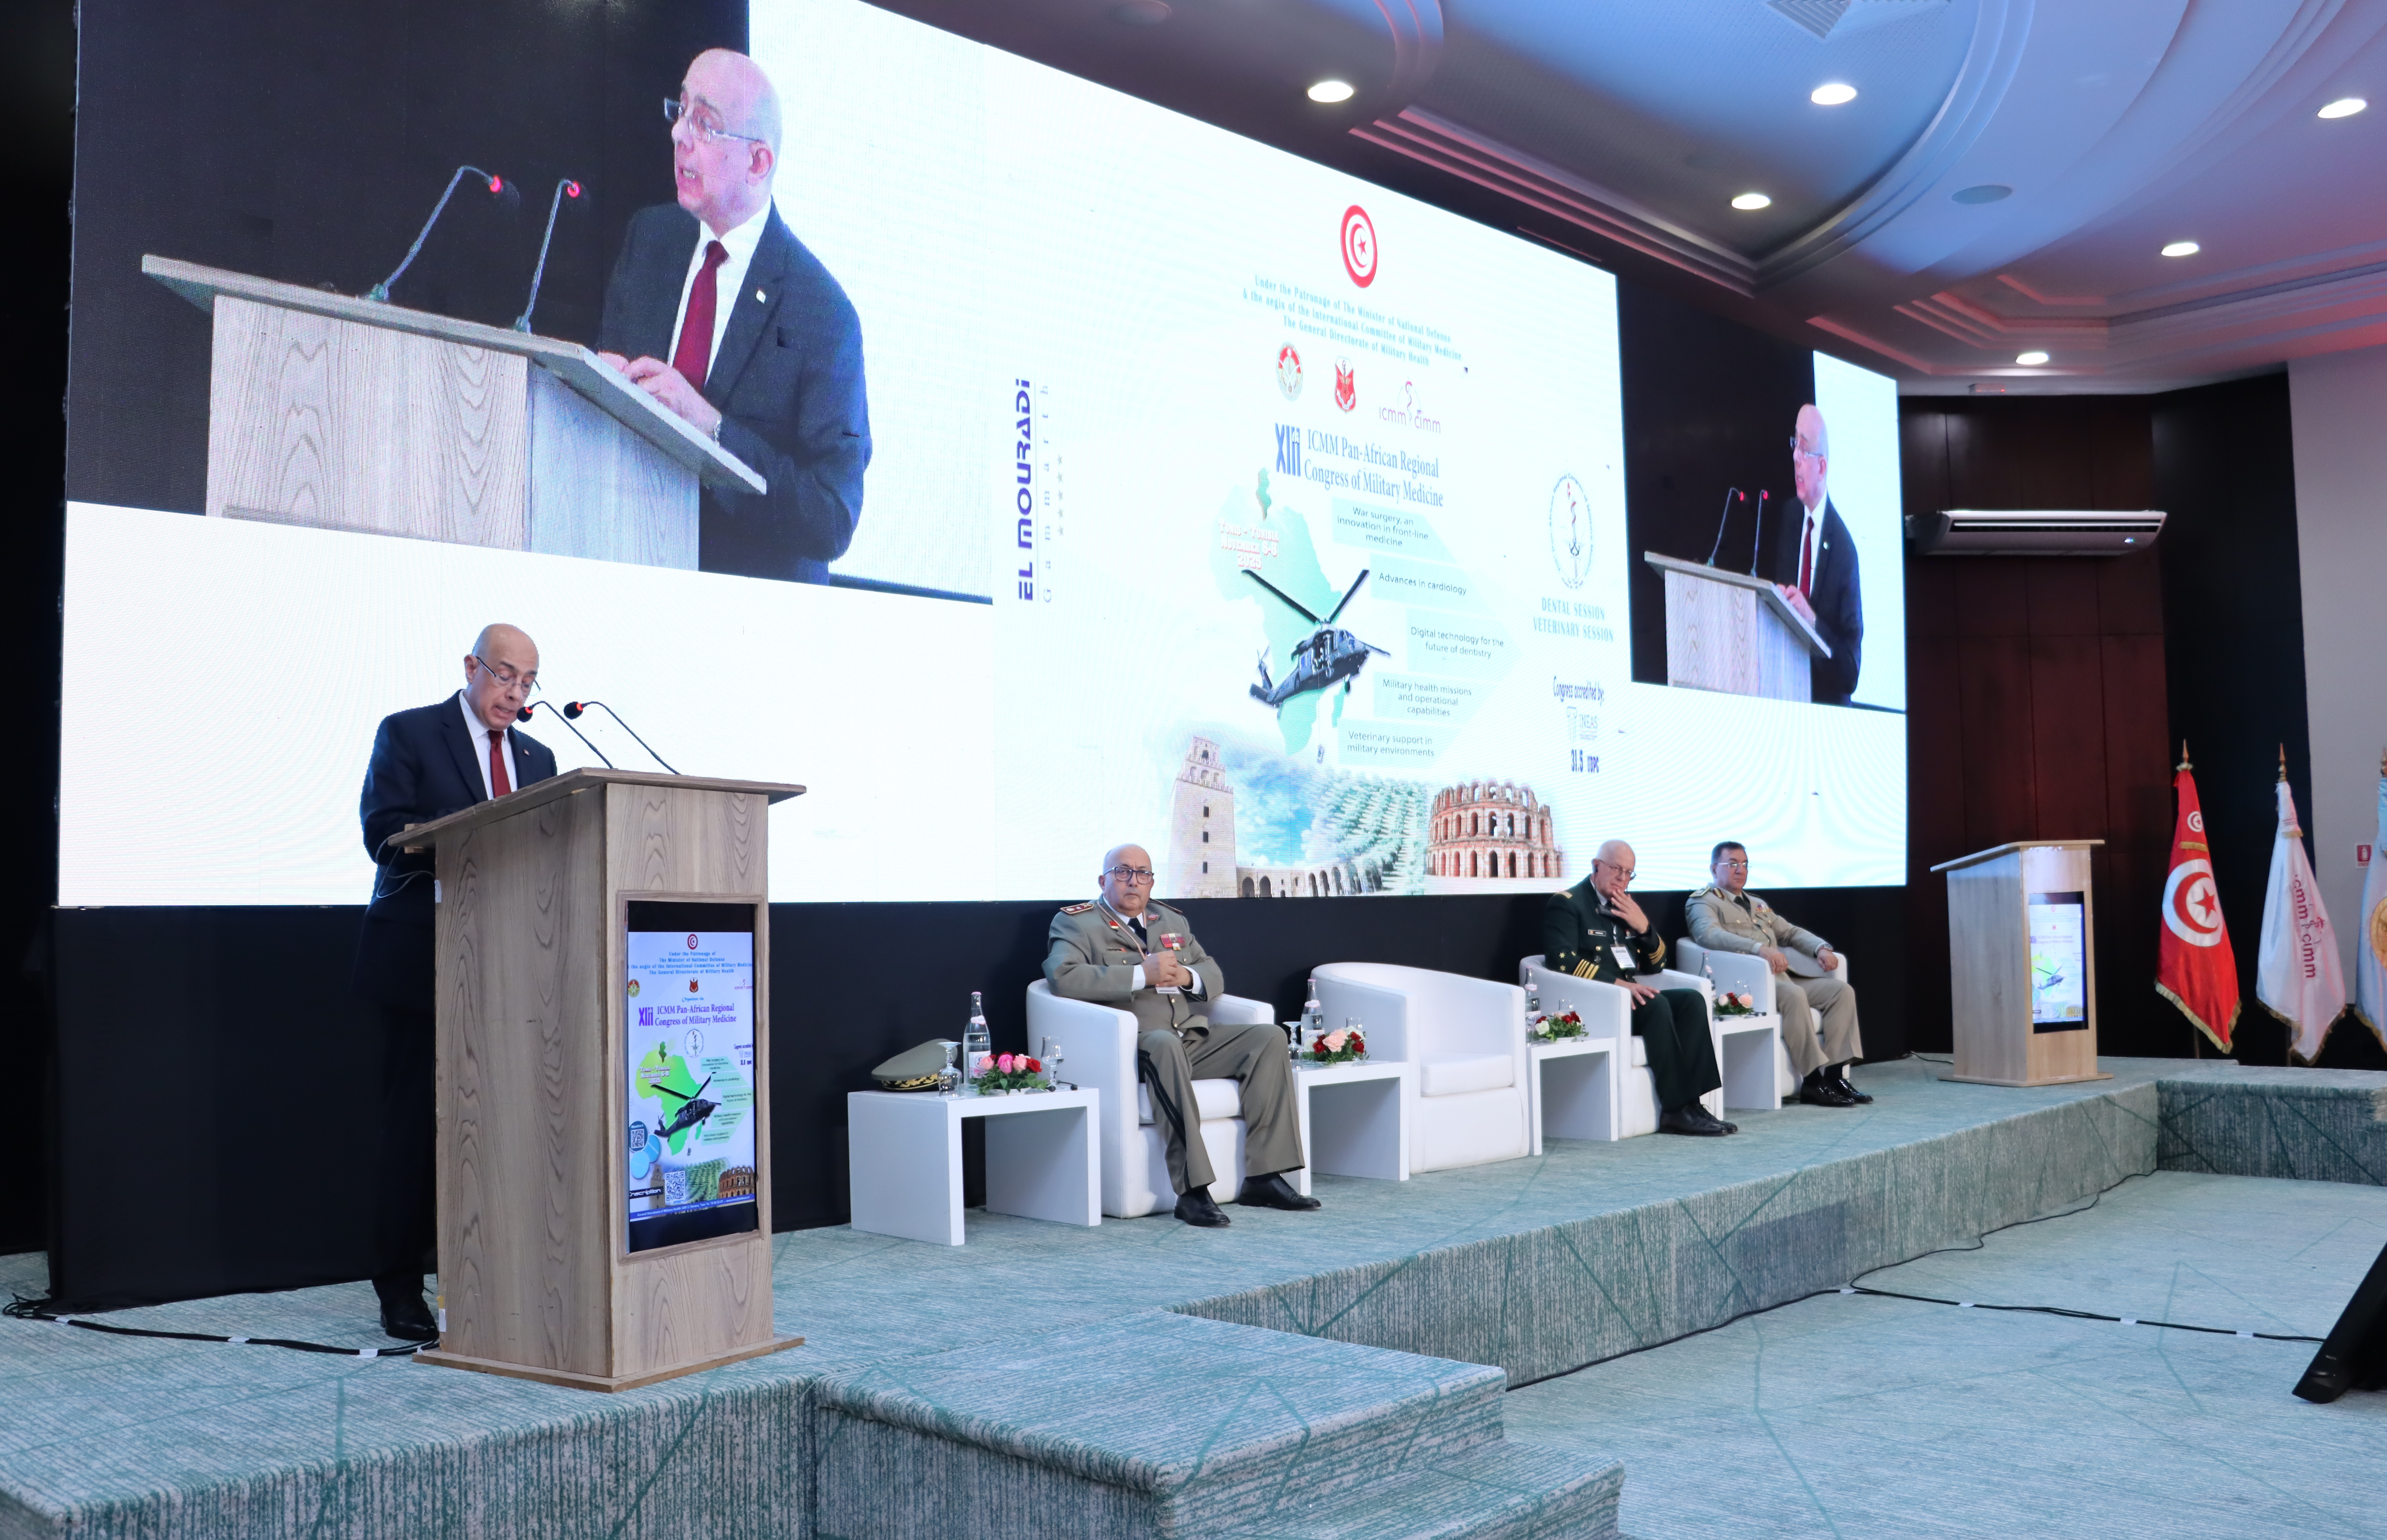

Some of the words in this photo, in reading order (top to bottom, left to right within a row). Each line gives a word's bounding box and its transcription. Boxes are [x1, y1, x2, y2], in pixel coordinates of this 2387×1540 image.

[1255, 275, 1276, 290] Under
[1280, 283, 1291, 295] the
[1295, 287, 1330, 308] Patronage
[1334, 300, 1340, 309] of
[1343, 301, 1354, 314] The
[1358, 306, 1385, 323] Minister
[1388, 316, 1394, 326] of
[1397, 318, 1423, 335] National
[1427, 327, 1451, 343] Defense
[1251, 290, 1262, 303] the
[1266, 297, 1284, 310] aegis
[1288, 302, 1295, 312] of
[1298, 304, 1309, 316] the
[1312, 308, 1358, 331] International
[1361, 322, 1396, 342] Committee
[1399, 334, 1404, 344] of
[1408, 336, 1432, 353] Military
[1435, 344, 1461, 361] Medicine
[1283, 315, 1296, 328] The
[1299, 319, 1326, 337] General
[1330, 328, 1368, 348] Directorate
[1372, 342, 1378, 352] of
[1381, 343, 1405, 361] Military
[1409, 351, 1429, 366] Health
[1308, 429, 1339, 456] ICMM
[1342, 437, 1397, 469] Pan-African
[1400, 450, 1439, 479] Regional
[1305, 459, 1349, 490] Congress
[1351, 469, 1361, 490] of
[1363, 471, 1400, 504] Military
[1403, 480, 1443, 507] Medicine
[1353, 506, 1368, 516] War
[1366, 534, 1403, 547] medicine
[1383, 524, 1391, 533] in
[1393, 525, 1428, 540] front-line
[1018, 561, 1033, 601] EL
[1379, 572, 1416, 587] Advances
[1418, 578, 1426, 588] in
[1428, 582, 1466, 596] cardiology
[1542, 597, 1570, 615] DENTAL
[1574, 603, 1604, 621] SESSION
[1411, 627, 1435, 638] Digital
[1438, 631, 1479, 645] technology
[1481, 636, 1490, 645] for
[1493, 638, 1504, 647] the
[1533, 616, 1579, 637] VETERINARY
[1583, 624, 1613, 642] SESSION
[1426, 641, 1448, 652] future
[1459, 646, 1491, 659] dentistry
[1383, 678, 1412, 691] Military
[1415, 682, 1438, 693] health
[1440, 685, 1472, 696] missions
[1398, 693, 1412, 702] and
[1415, 696, 1458, 706] operational
[1407, 706, 1450, 716] capabilities
[1348, 730, 1390, 744] Veterinary
[1392, 735, 1423, 745] support
[1425, 736, 1432, 745] in
[1347, 743, 1378, 755] military
[1380, 746, 1434, 756] environments
[2302, 934, 2316, 978] cimm
[657, 1005, 676, 1015] ICMM
[677, 1004, 710, 1014] Pan-African
[711, 1003, 734, 1014] Regional
[655, 1017, 681, 1028] Congress
[682, 1016, 688, 1025] of
[689, 1015, 711, 1026] Military
[712, 1014, 737, 1023] Medicine
